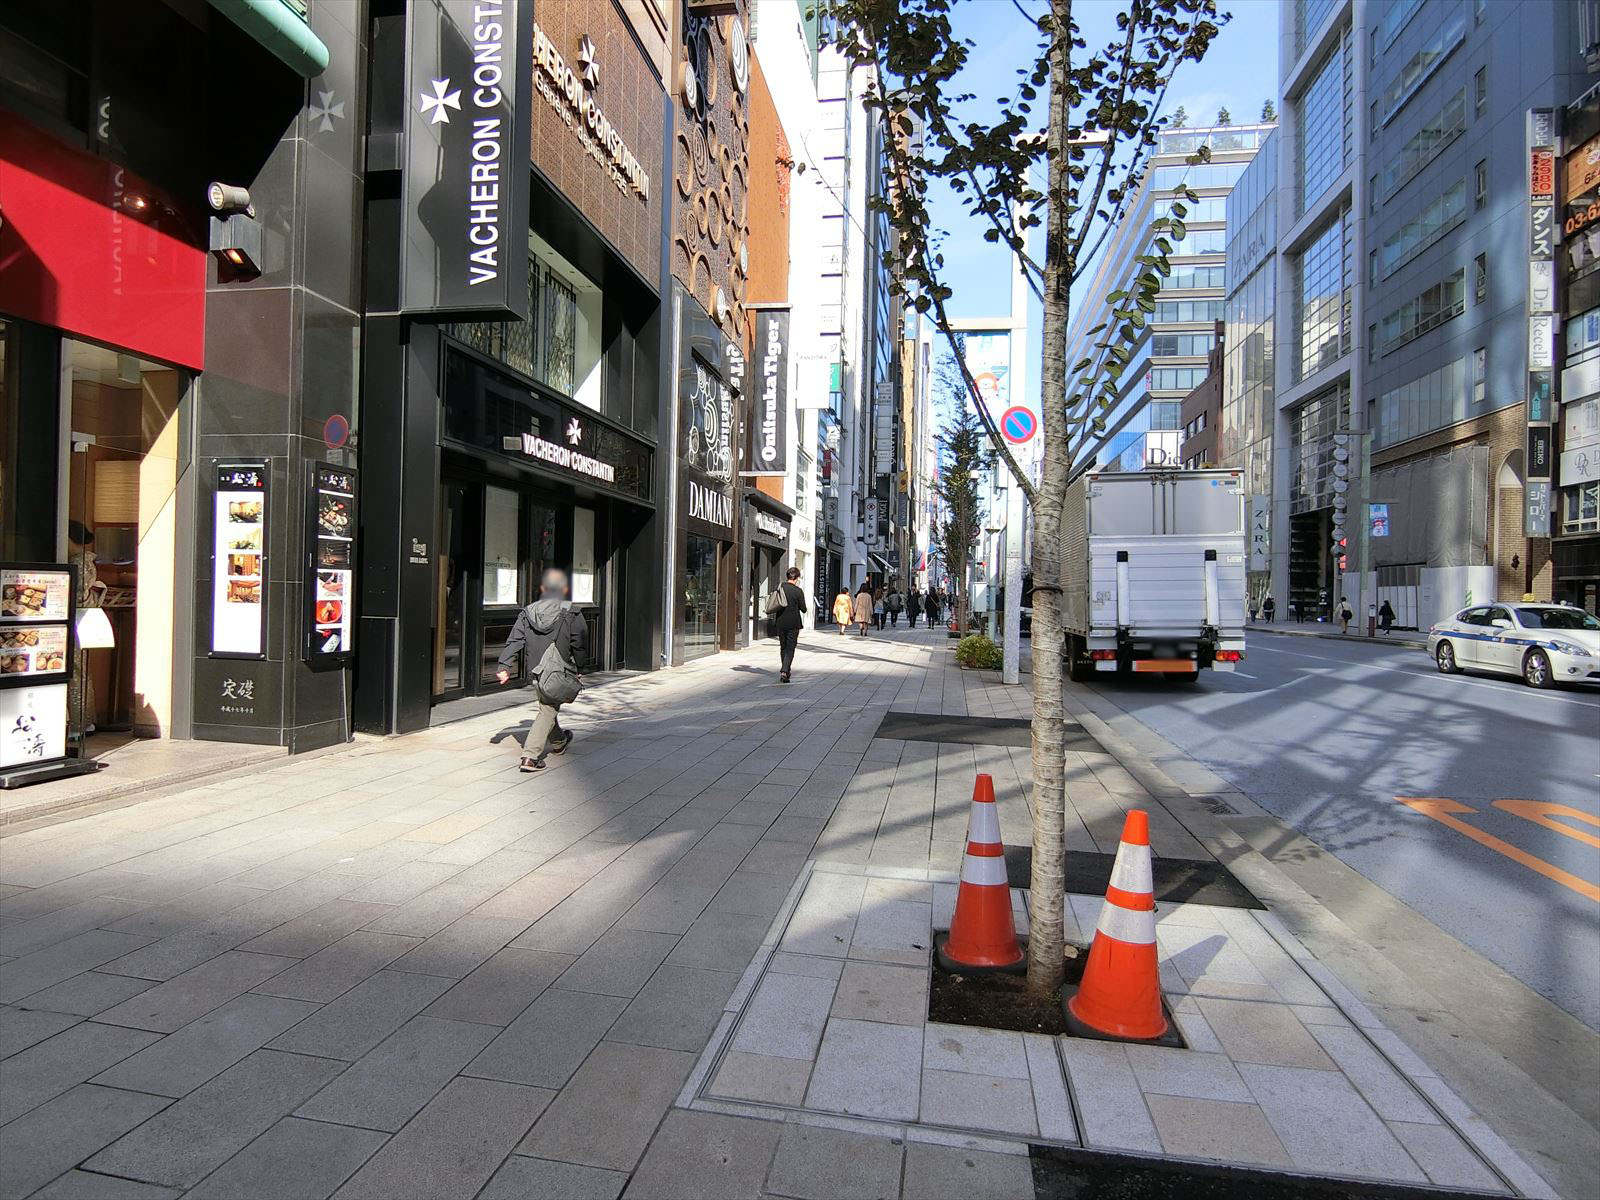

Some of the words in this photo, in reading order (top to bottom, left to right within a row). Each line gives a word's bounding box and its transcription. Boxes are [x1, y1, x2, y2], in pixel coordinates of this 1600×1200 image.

[473, 0, 504, 108] CONST
[533, 24, 583, 114] HERON
[587, 97, 649, 203] CONSTANTIN
[470, 119, 501, 285] VACHERON
[1533, 206, 1551, 255] ダンス
[1233, 233, 1265, 279] ZARA
[522, 432, 571, 468] VACHERON
[571, 451, 615, 483] CONSTANTIN
[688, 481, 732, 529] DAMIANI
[1530, 491, 1540, 531] シロー
[1254, 509, 1265, 556] ZARA
[221, 678, 255, 700] 定礎
